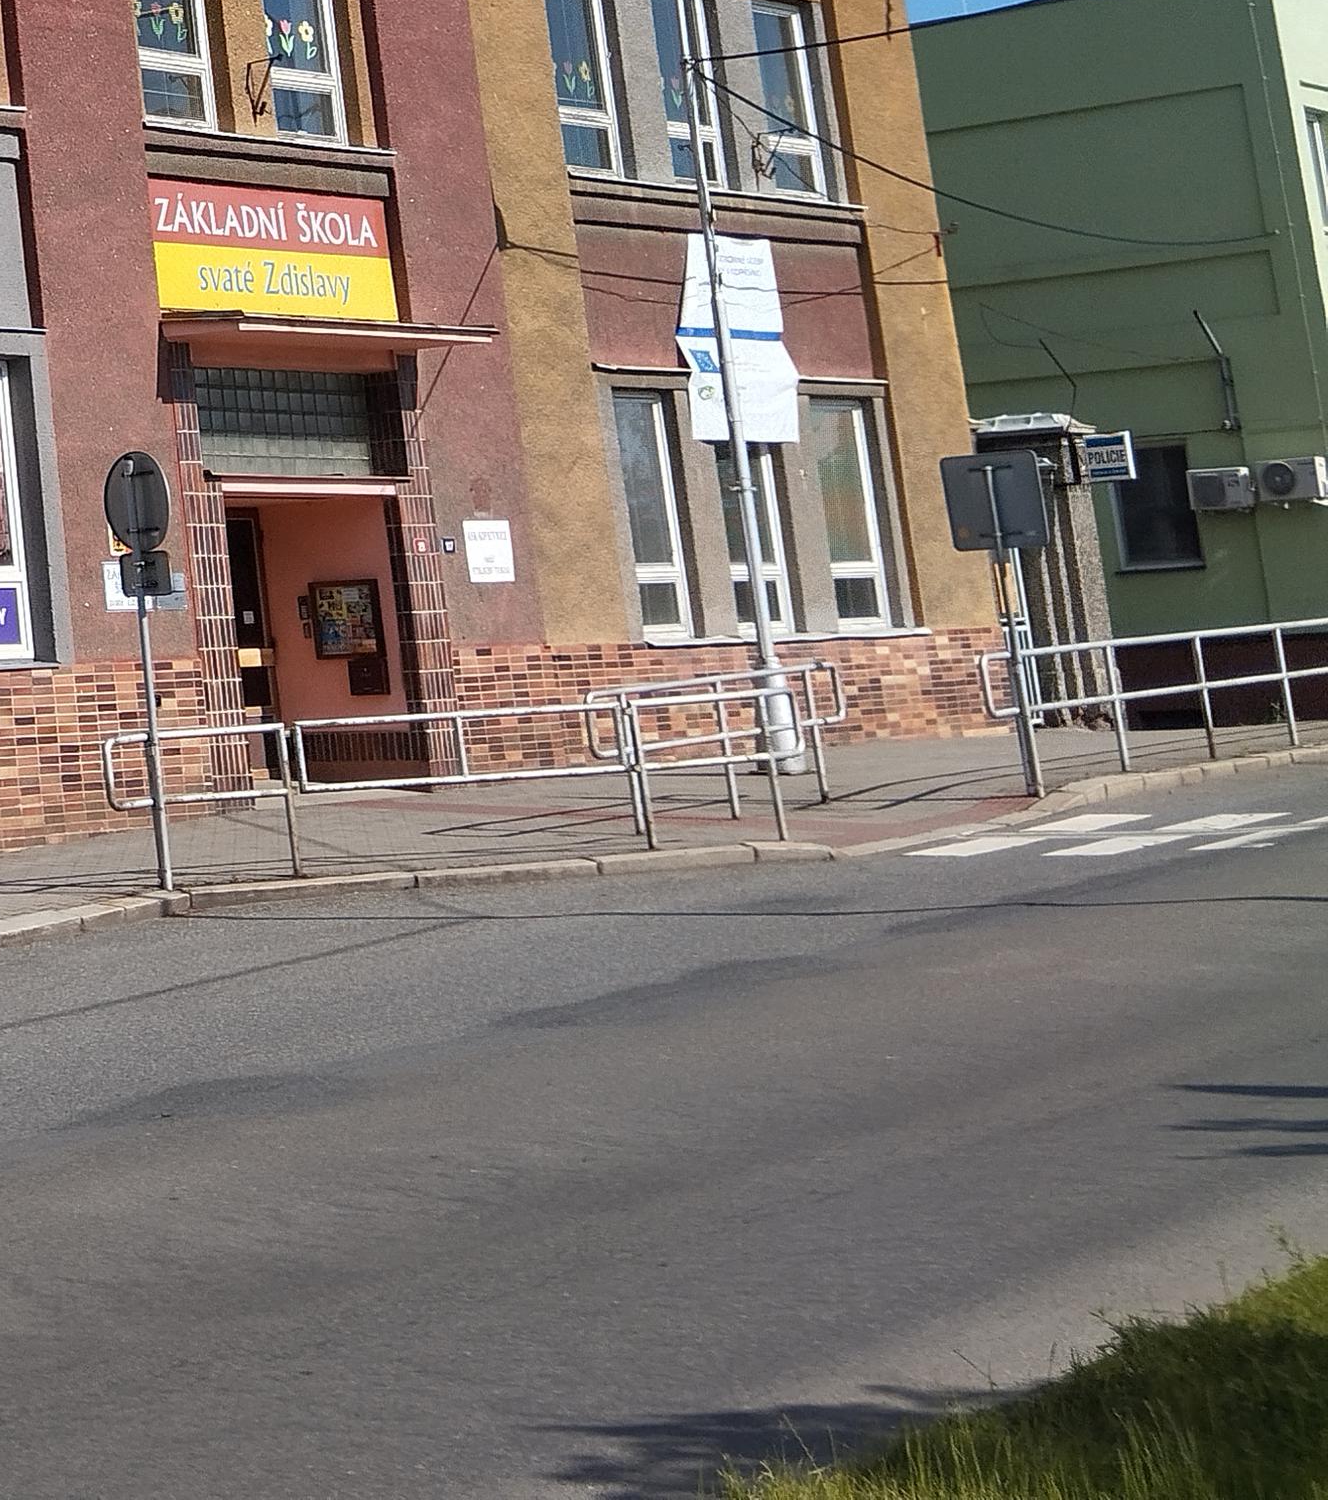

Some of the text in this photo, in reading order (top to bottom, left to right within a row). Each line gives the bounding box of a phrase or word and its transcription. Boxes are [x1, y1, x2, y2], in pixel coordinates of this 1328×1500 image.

[154, 192, 379, 249] ZÁKLADNÍ ŠKOLA
[198, 261, 350, 305] svaté Zdislavy
[1088, 450, 1126, 465] POLICIE
